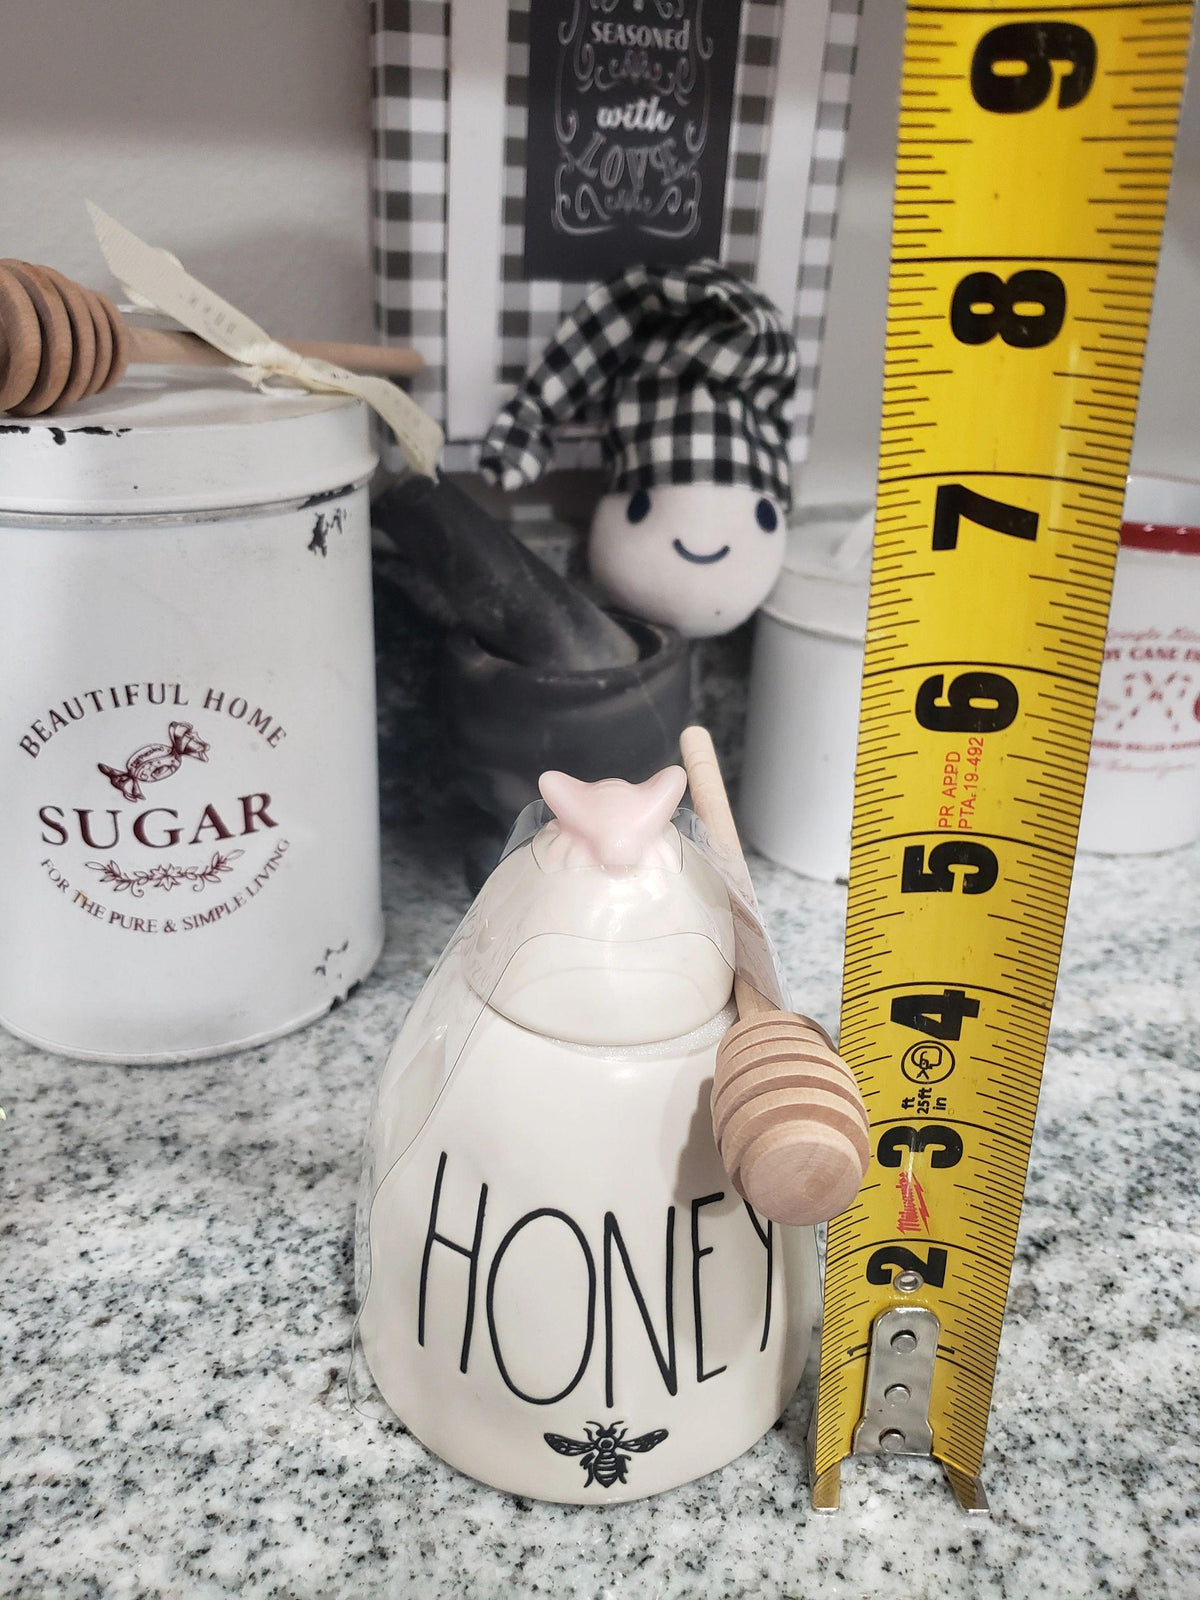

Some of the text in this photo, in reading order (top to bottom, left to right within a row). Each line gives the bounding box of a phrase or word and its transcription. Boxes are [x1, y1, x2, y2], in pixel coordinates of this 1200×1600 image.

[970, 21, 1097, 114] 9
[597, 96, 675, 132] with
[951, 269, 1067, 349] 8
[932, 484, 1039, 551] 7
[19, 682, 287, 759] BEAUTIFUL HOME
[915, 672, 1019, 733] 6
[938, 751, 961, 828] PR APPD
[38, 792, 279, 850] SUGAR
[40, 837, 291, 933] FOR THE PURE & SIMPLE LIVING
[901, 841, 999, 895] 5
[890, 989, 980, 1041] 4
[901, 1096, 915, 1110] ft
[917, 1087, 932, 1115] 25ft
[933, 1096, 947, 1111] in
[877, 1125, 963, 1169] 3
[418, 1151, 774, 1409] HONEY
[866, 1246, 948, 1288] 2
